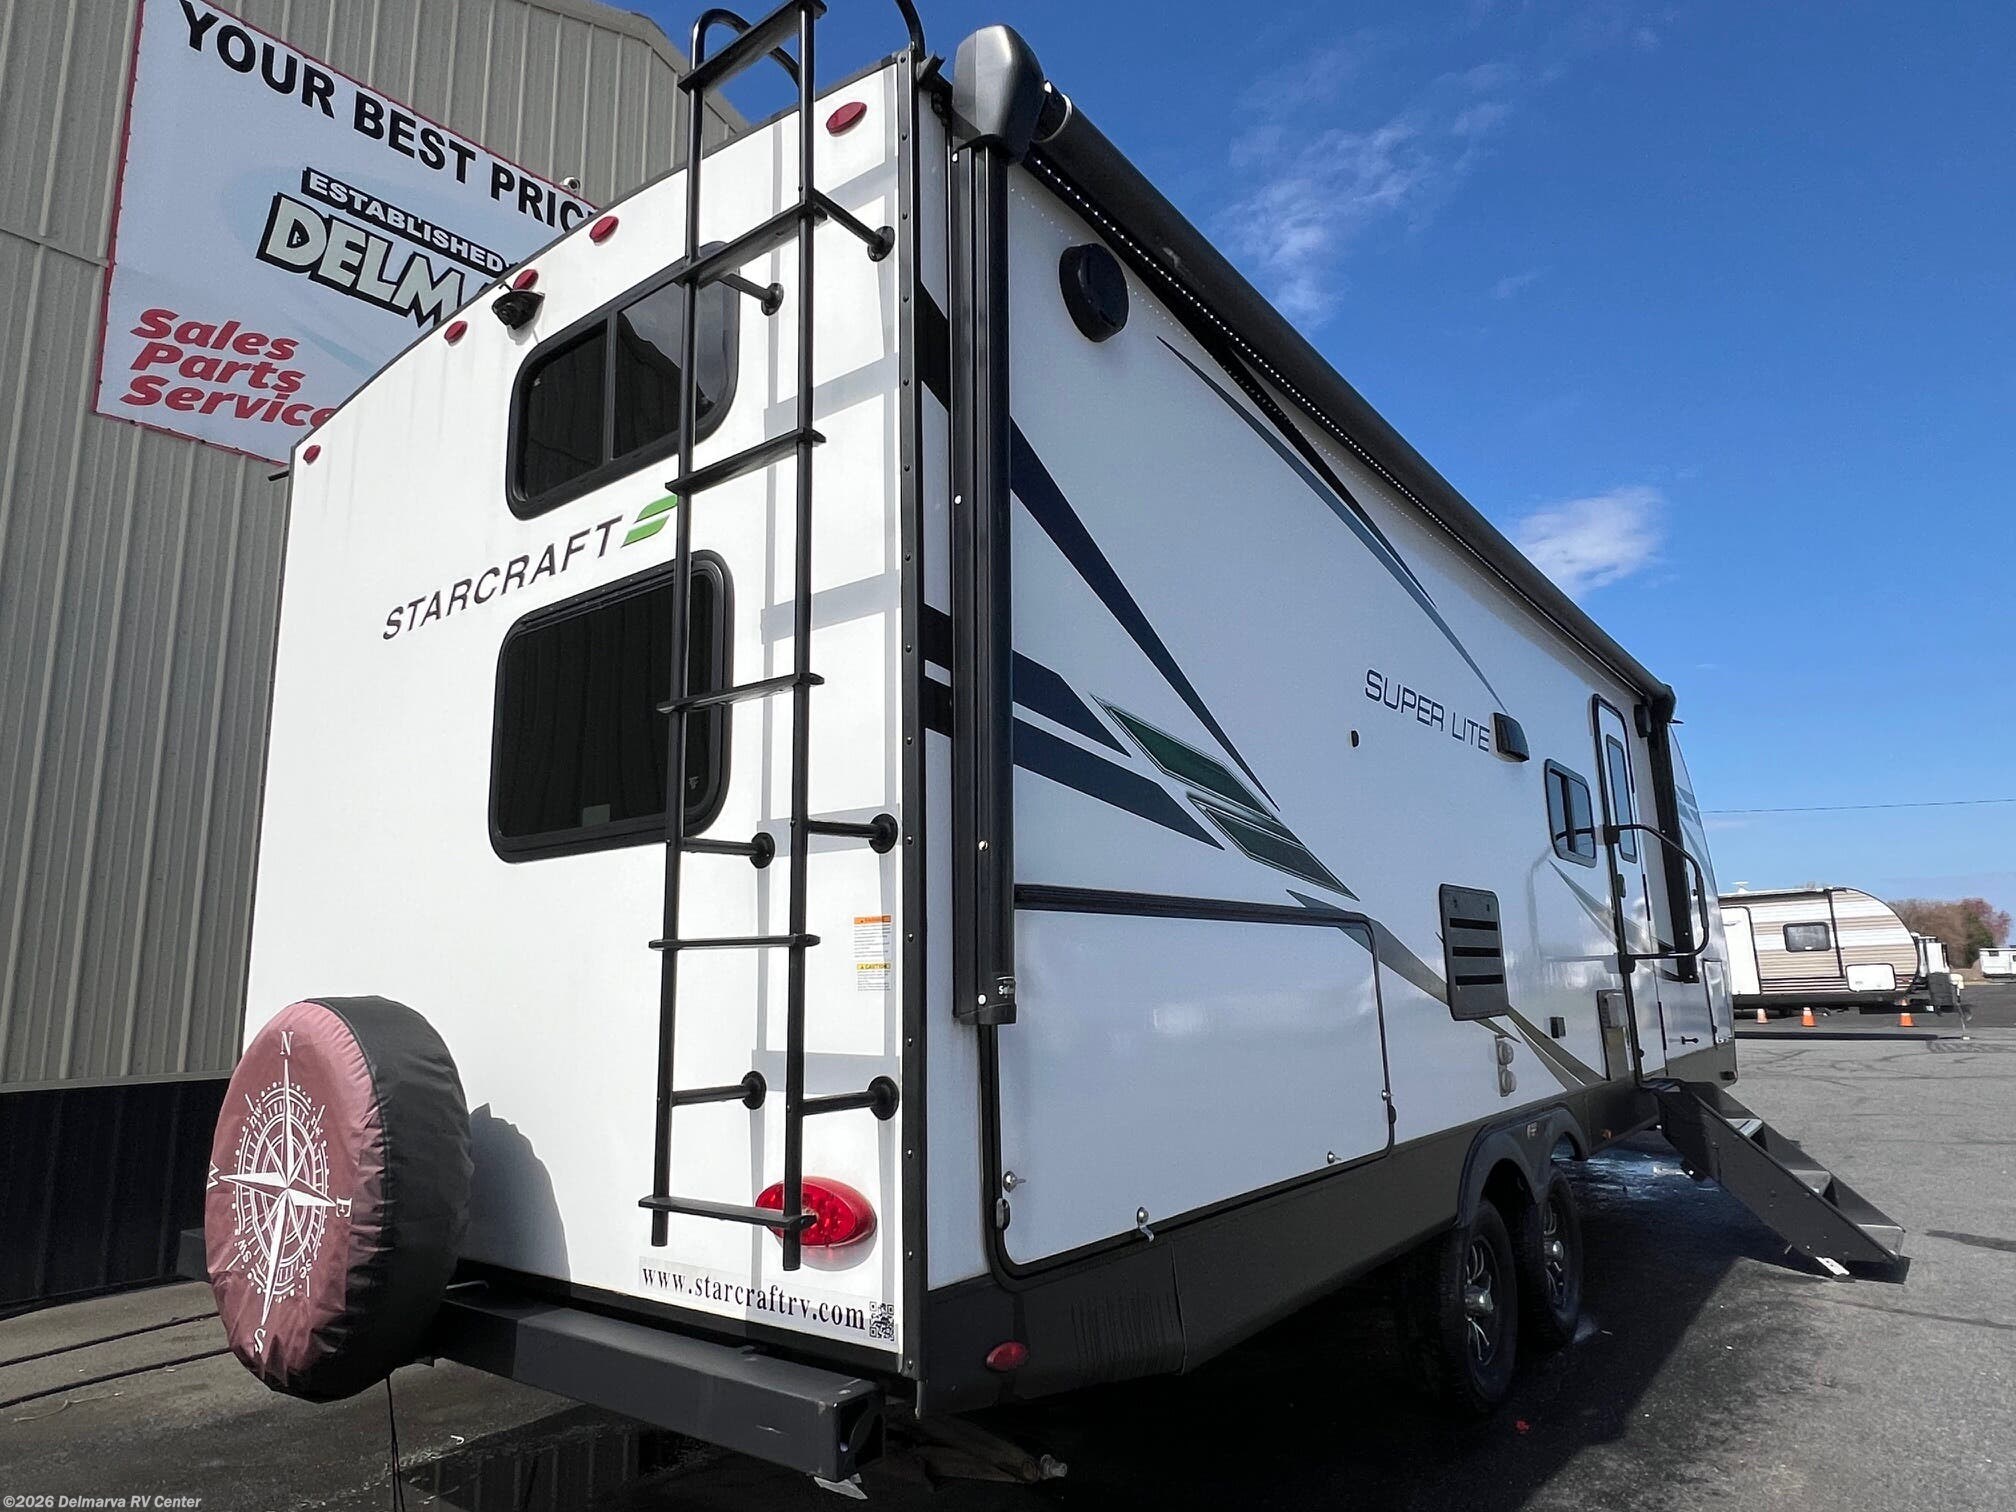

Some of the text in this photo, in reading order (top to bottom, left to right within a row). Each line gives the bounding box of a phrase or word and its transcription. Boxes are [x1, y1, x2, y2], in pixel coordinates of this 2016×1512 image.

[180, 0, 594, 232] YOUR BEST PRIC
[306, 169, 506, 274] ESTABLISHED
[258, 196, 476, 327] DELM
[130, 308, 299, 360] Sales
[130, 341, 306, 393] Parts
[382, 515, 624, 640] STARCRAFT
[1365, 669, 1490, 752] SUPER LITE
[280, 1031, 294, 1056] N
[336, 1197, 353, 1218] E
[642, 1268, 866, 1330] www.starcraftrv.com
[254, 1328, 266, 1353] S
